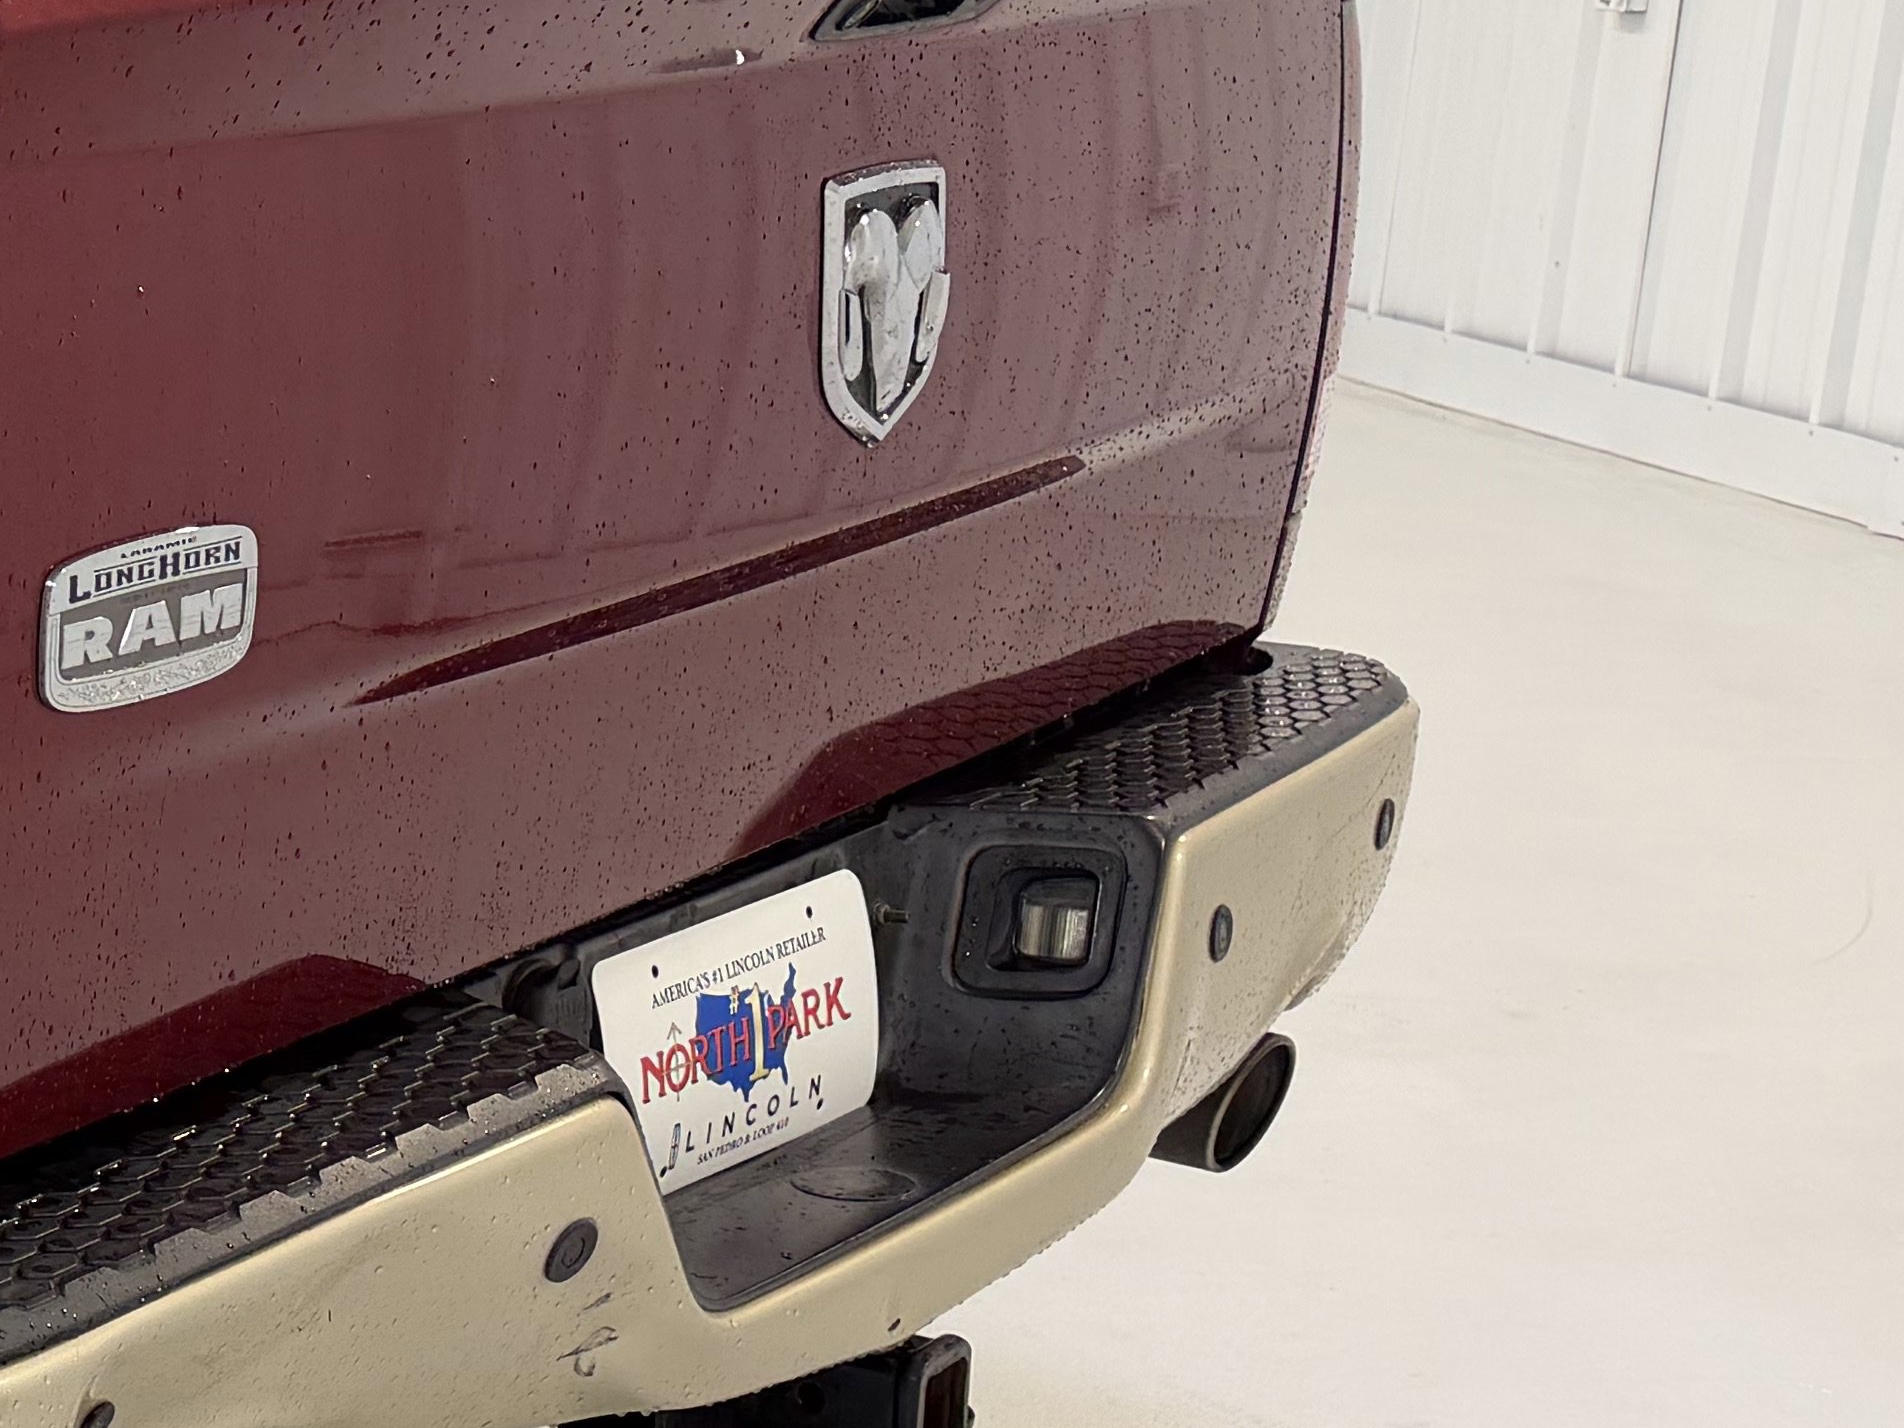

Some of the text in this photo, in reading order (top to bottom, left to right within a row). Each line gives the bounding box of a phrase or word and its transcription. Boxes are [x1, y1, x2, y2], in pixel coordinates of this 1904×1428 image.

[68, 540, 241, 604] LONGHORN
[61, 583, 244, 670] RAM
[652, 971, 711, 1009] AMERICA'S
[725, 946, 775, 979] LINCOLN
[776, 926, 826, 959] RETAILER
[640, 976, 852, 1104] NORTH PARK
[685, 1074, 822, 1152] LINCOLN
